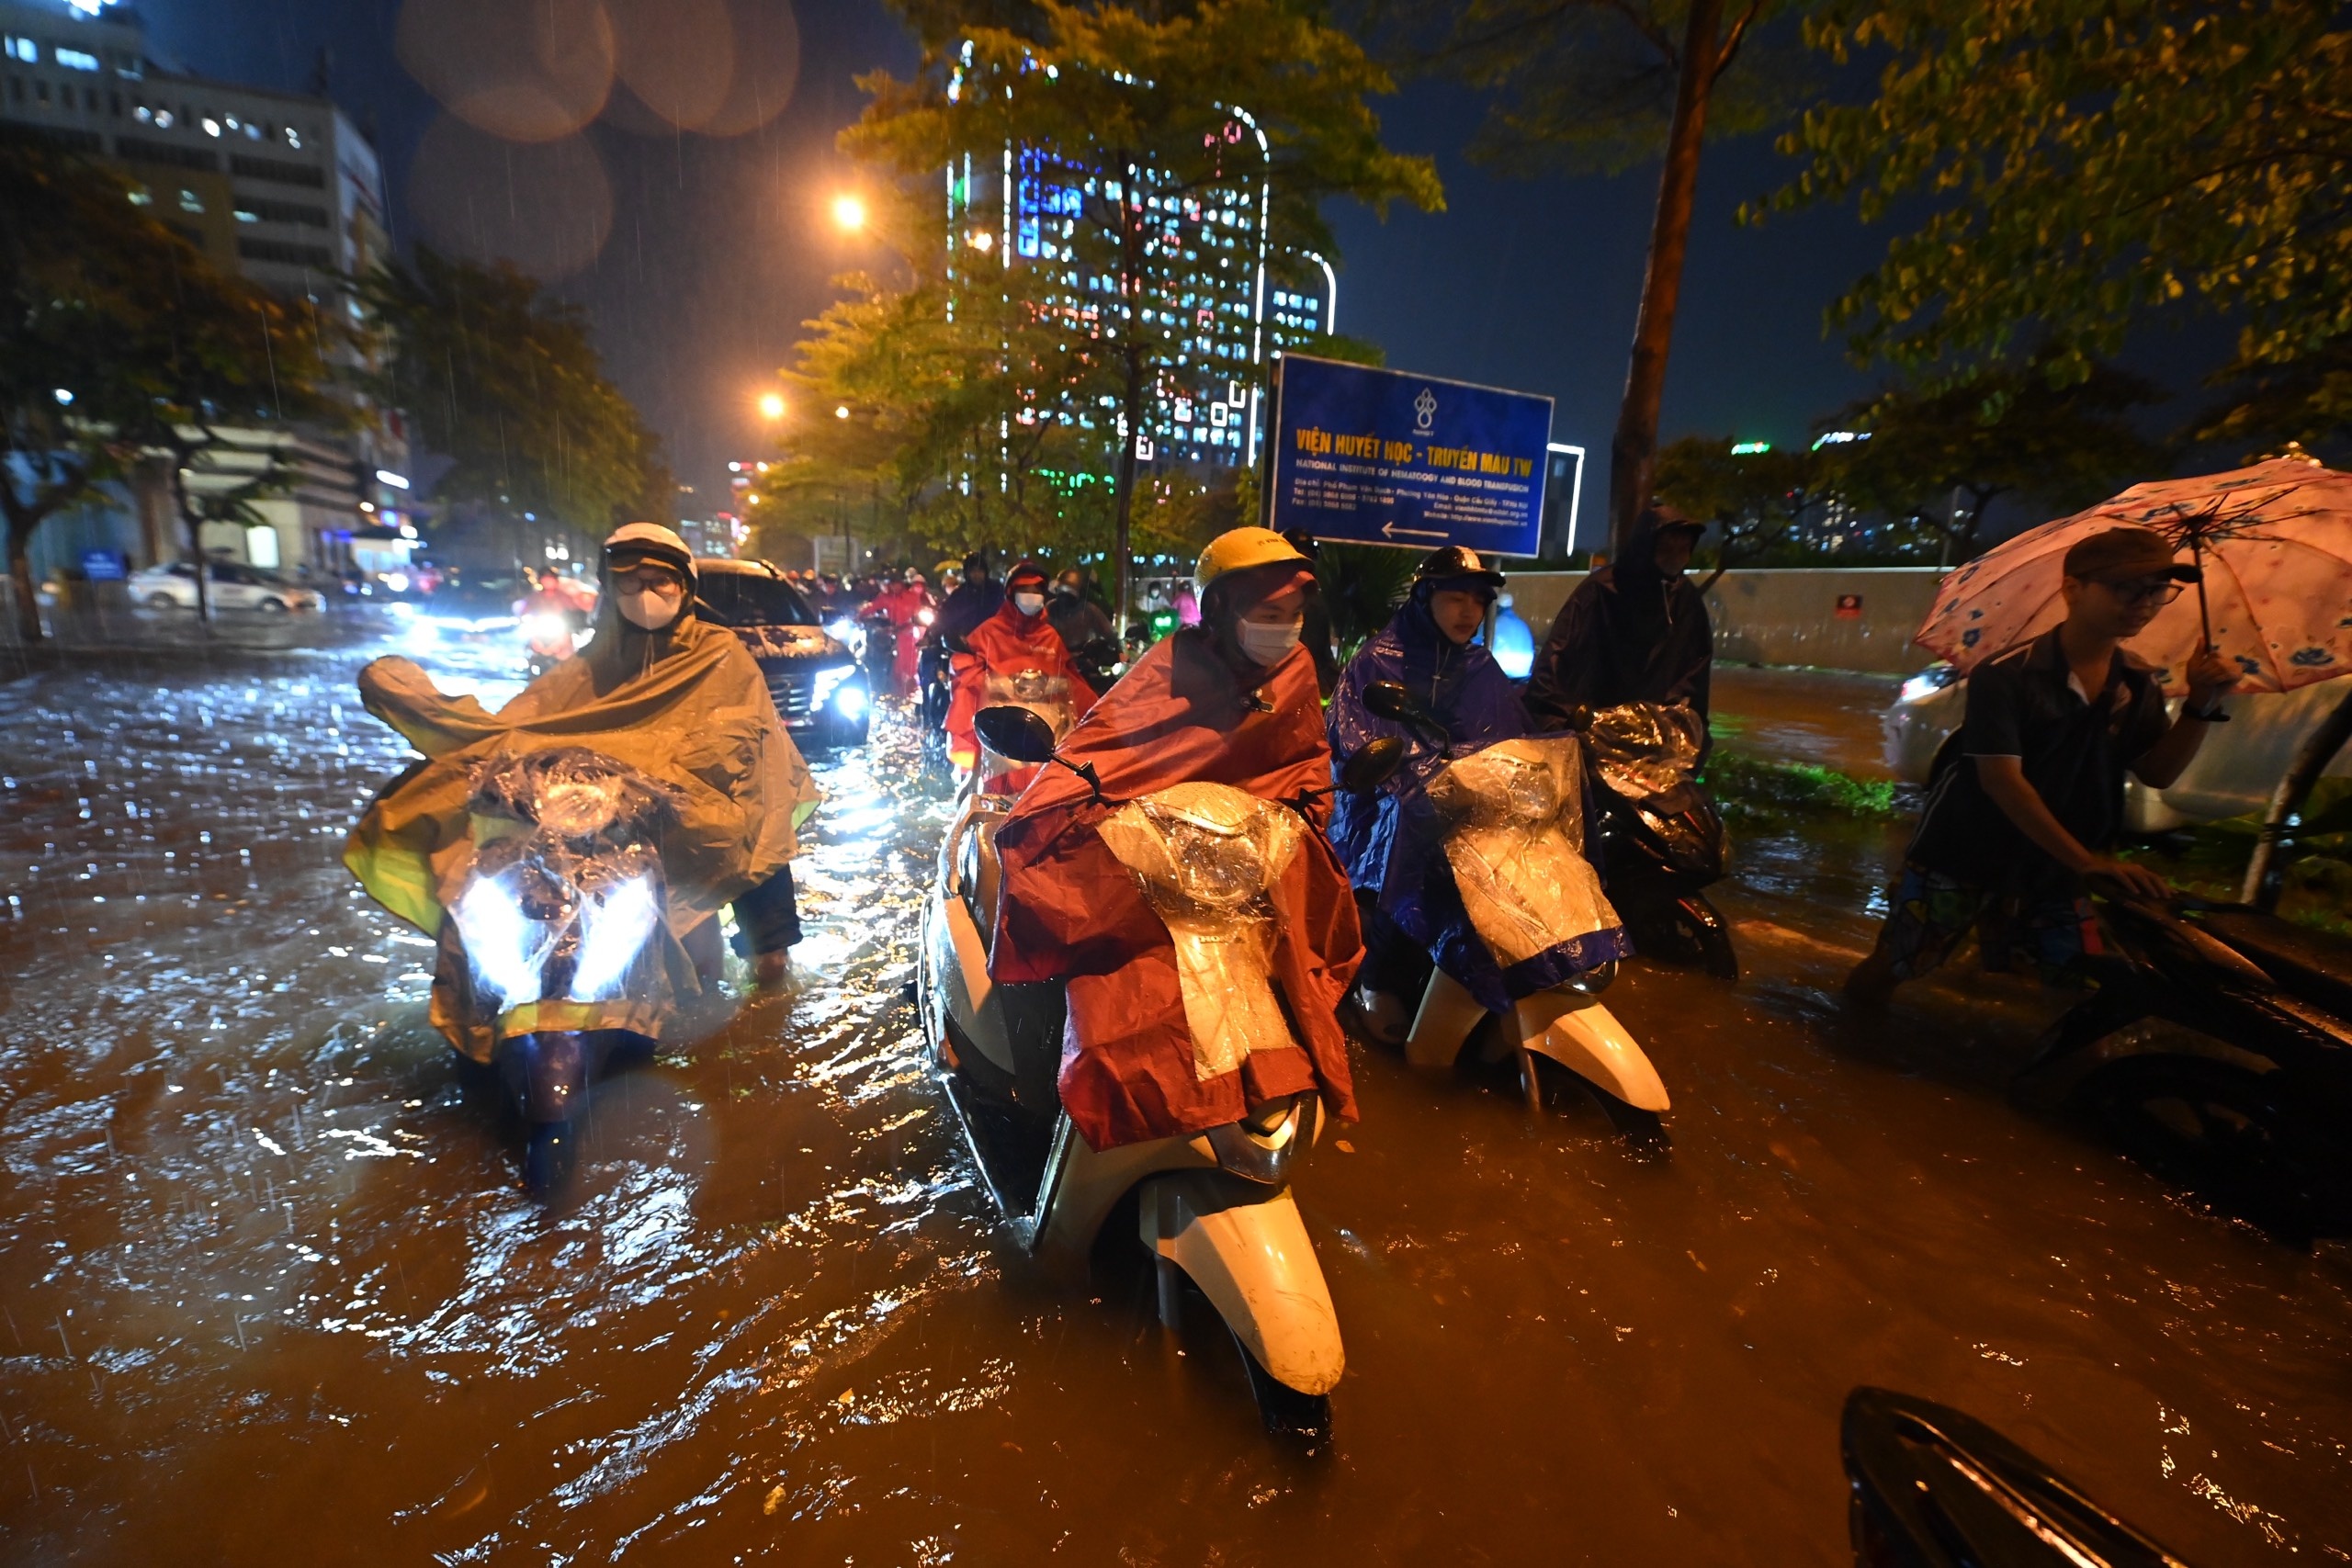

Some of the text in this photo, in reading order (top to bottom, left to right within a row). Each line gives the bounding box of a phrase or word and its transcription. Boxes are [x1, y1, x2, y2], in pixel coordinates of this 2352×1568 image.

[1296, 425, 1331, 457] VIỆN
[1335, 432, 1381, 459] HUYẾT
[1384, 441, 1413, 467] HỌC
[1513, 457, 1532, 479] TW
[1295, 458, 1337, 471] NATIONAL
[1339, 463, 1375, 477] INSTITUTE
[1378, 468, 1389, 478] OF
[1440, 475, 1456, 485] AND
[1457, 477, 1482, 488] BLOOD
[1484, 479, 1529, 493] TRANSFUSION
